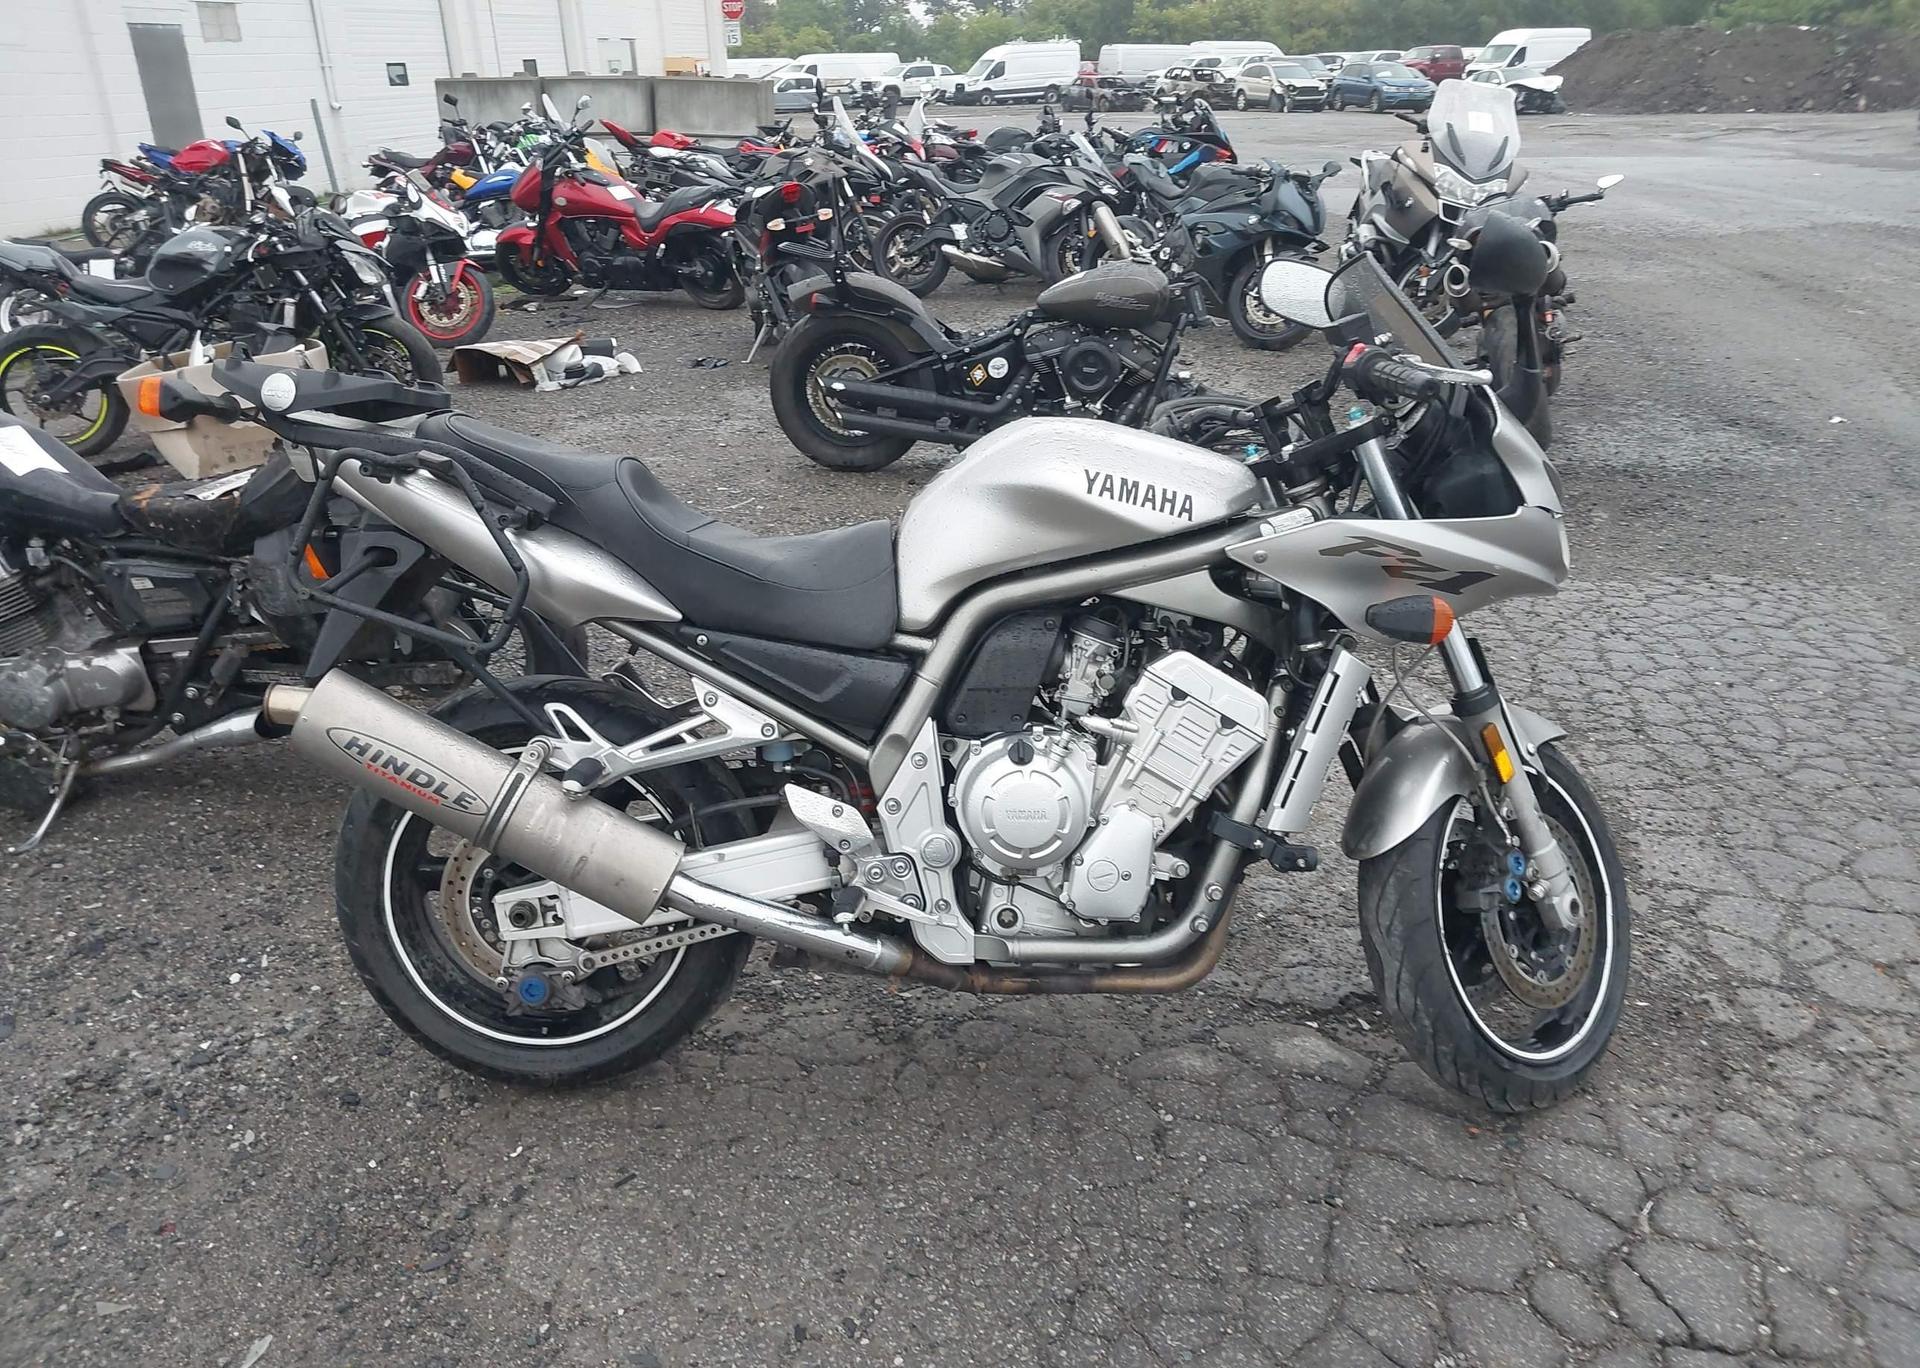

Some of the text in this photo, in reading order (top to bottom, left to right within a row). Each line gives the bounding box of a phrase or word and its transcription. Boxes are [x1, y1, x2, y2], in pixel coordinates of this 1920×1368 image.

[723, 2, 742, 12] STOP
[727, 34, 739, 44] 15
[1084, 469, 1193, 522] YAMAHA
[343, 736, 477, 810] HINDLE
[364, 762, 441, 805] TITANIUM
